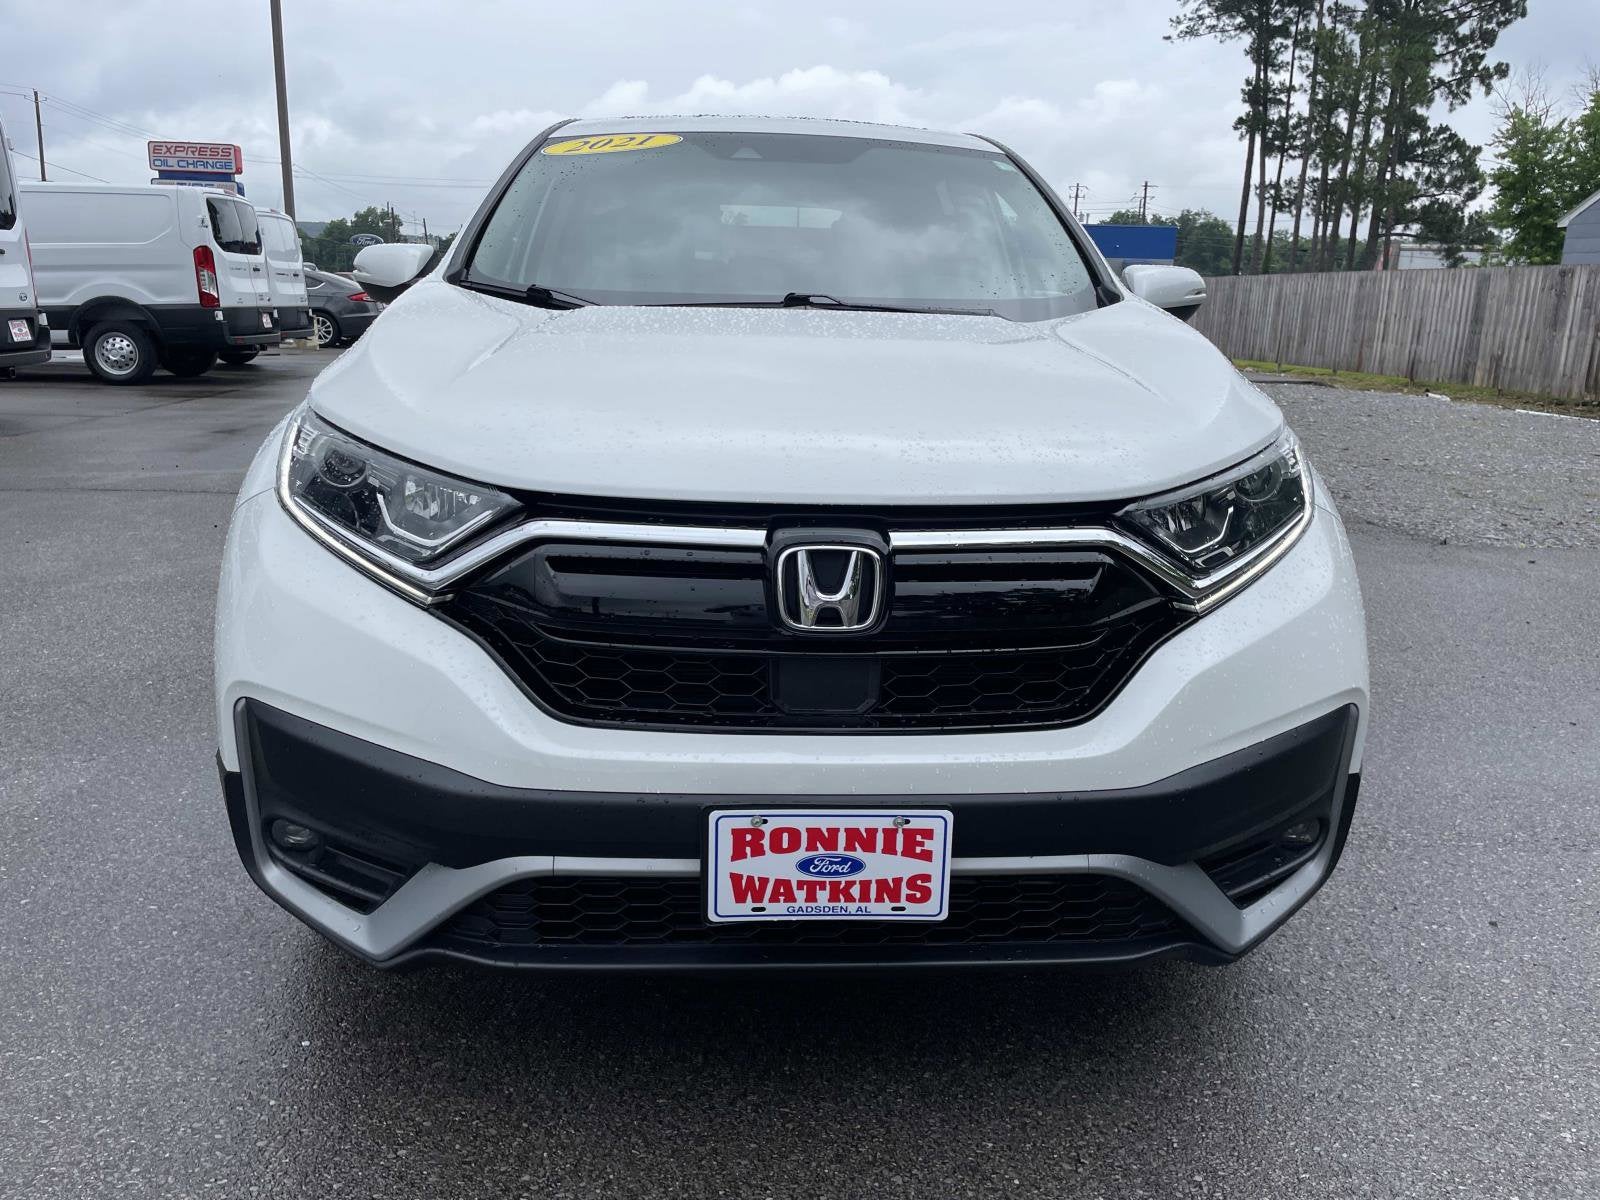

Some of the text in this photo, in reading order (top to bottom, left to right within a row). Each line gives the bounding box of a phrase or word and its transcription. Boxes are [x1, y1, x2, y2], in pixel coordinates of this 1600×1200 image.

[152, 145, 232, 157] EXPRESS
[564, 136, 654, 153] 2021
[153, 159, 233, 170] OIL CHANGE
[730, 826, 934, 863] RONNIE
[809, 857, 852, 873] Ford
[729, 873, 932, 904] WATKINS
[787, 905, 872, 914] GADSDEN, AL
